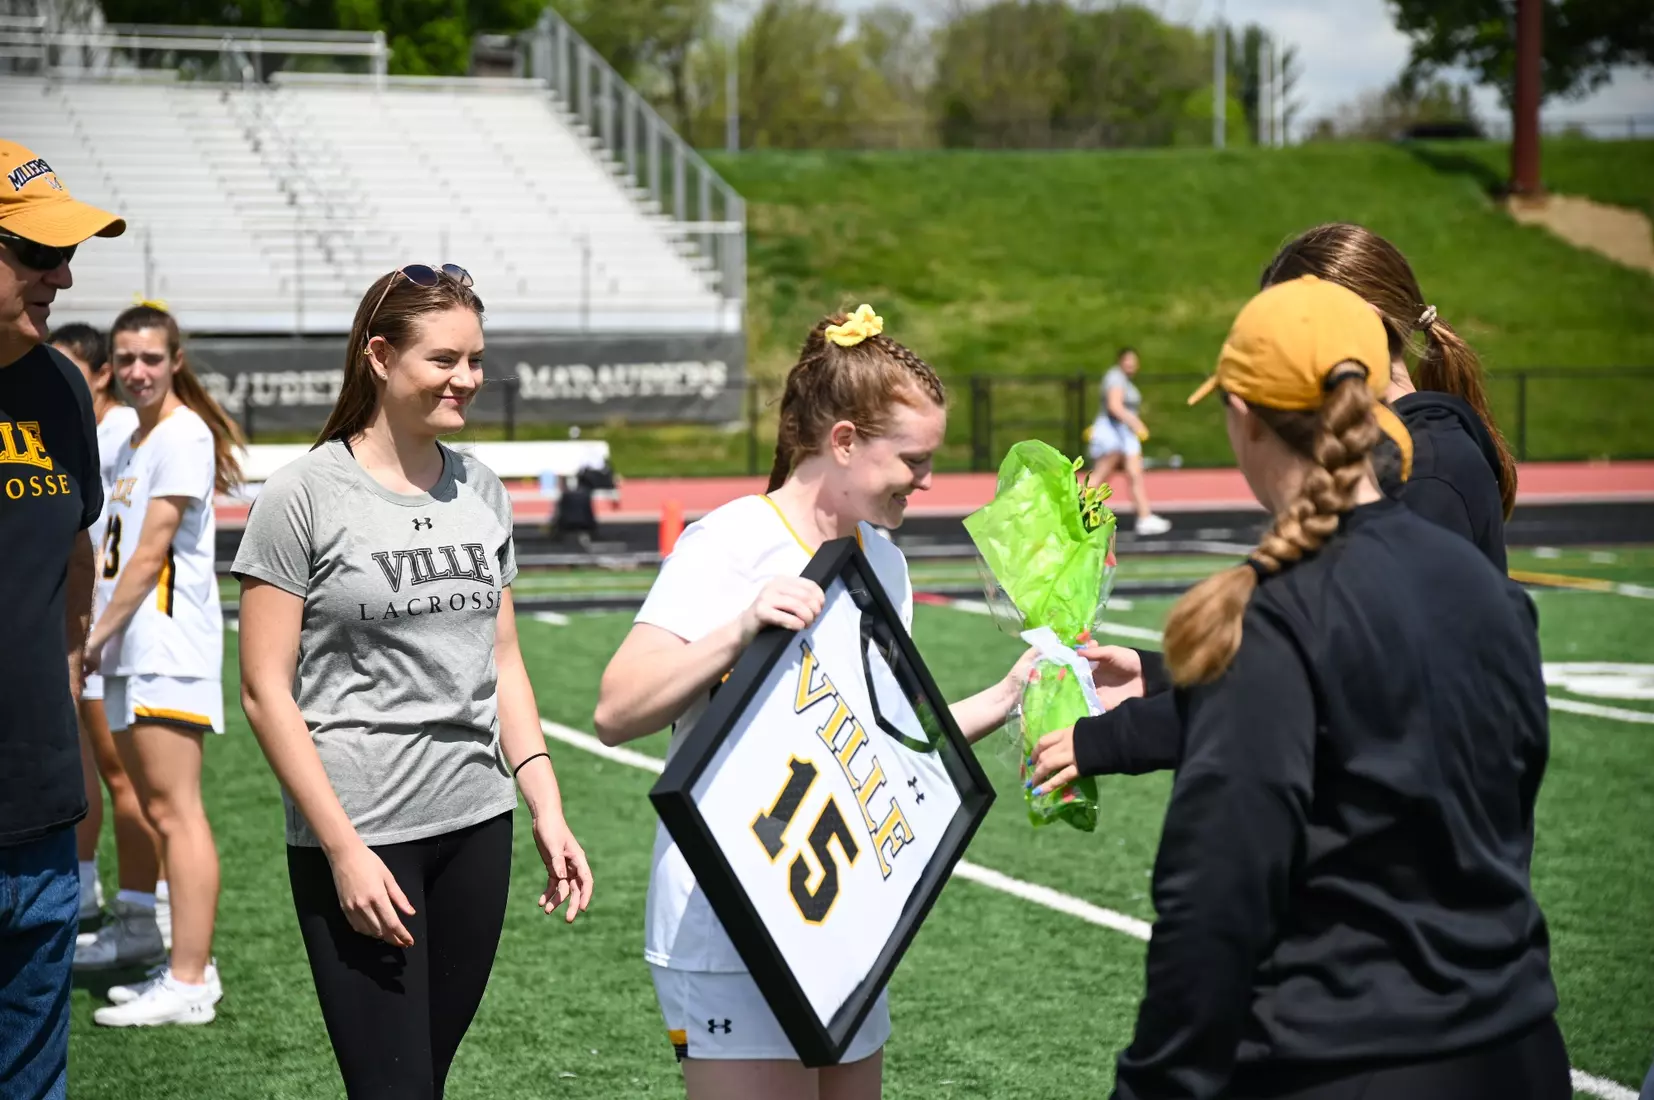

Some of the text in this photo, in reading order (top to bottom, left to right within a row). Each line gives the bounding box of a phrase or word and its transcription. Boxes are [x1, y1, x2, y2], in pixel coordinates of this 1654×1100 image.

[0, 421, 53, 471] LE
[371, 543, 495, 593] VILLE
[794, 639, 915, 881] VILLE
[749, 753, 862, 926] 15
